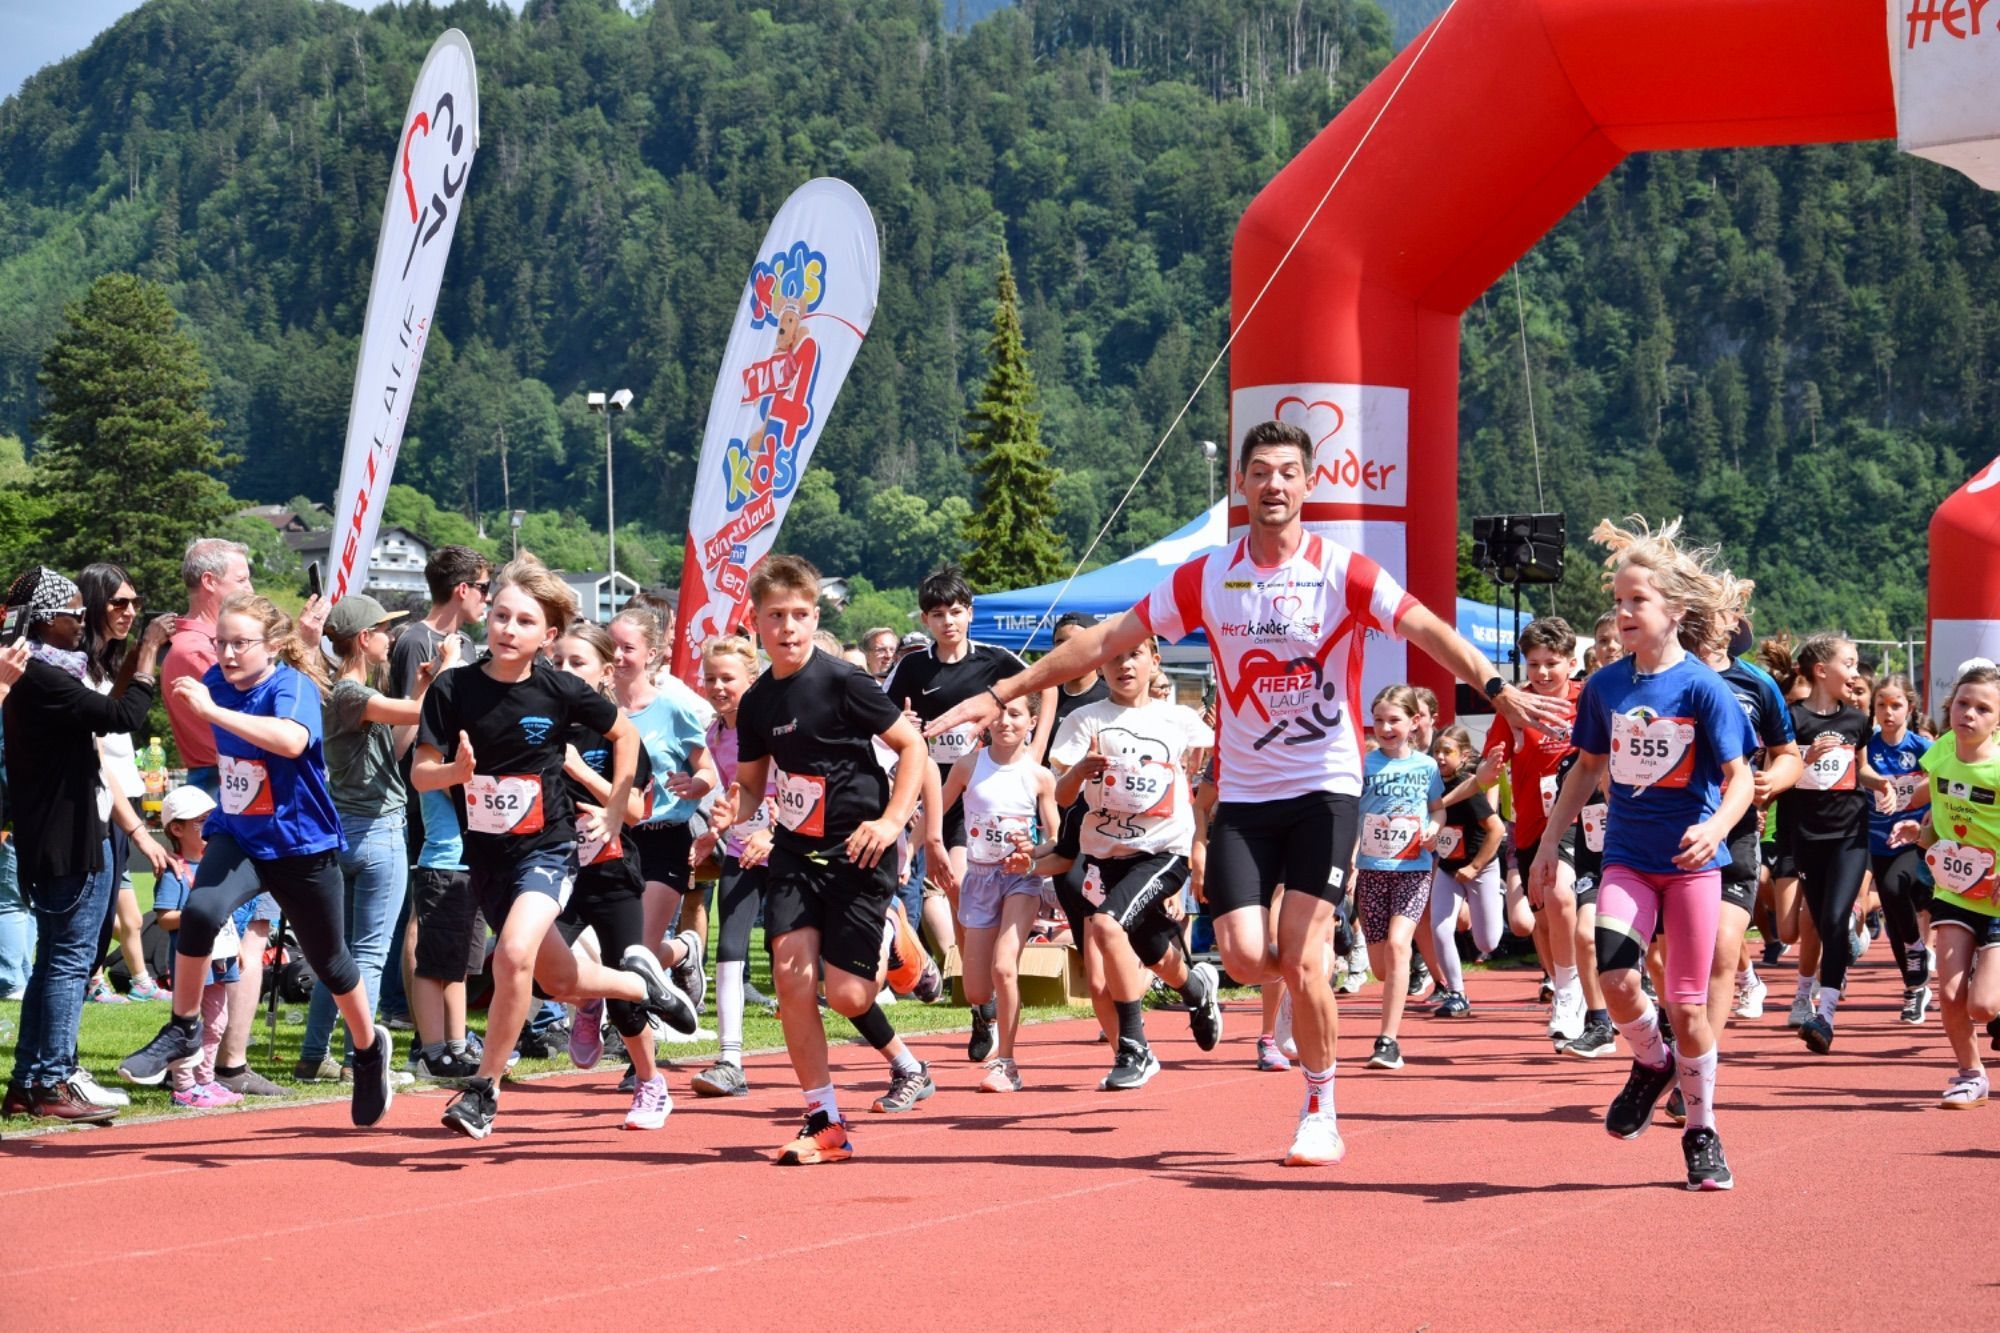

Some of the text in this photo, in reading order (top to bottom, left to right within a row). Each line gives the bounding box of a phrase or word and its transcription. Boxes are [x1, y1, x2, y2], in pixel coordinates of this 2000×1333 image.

[727, 434, 793, 504] kds
[1259, 674, 1312, 693] HERZ
[1270, 690, 1311, 708] LAUF
[1630, 738, 1669, 757] 555
[1814, 760, 1840, 771] 568
[226, 775, 249, 792] 549
[1125, 776, 1157, 793] 552
[1375, 784, 1421, 798] LUCKY
[484, 794, 519, 810] 562
[642, 821, 673, 831] NIK
[1374, 828, 1407, 841] 5174
[1943, 857, 1973, 876] 506
